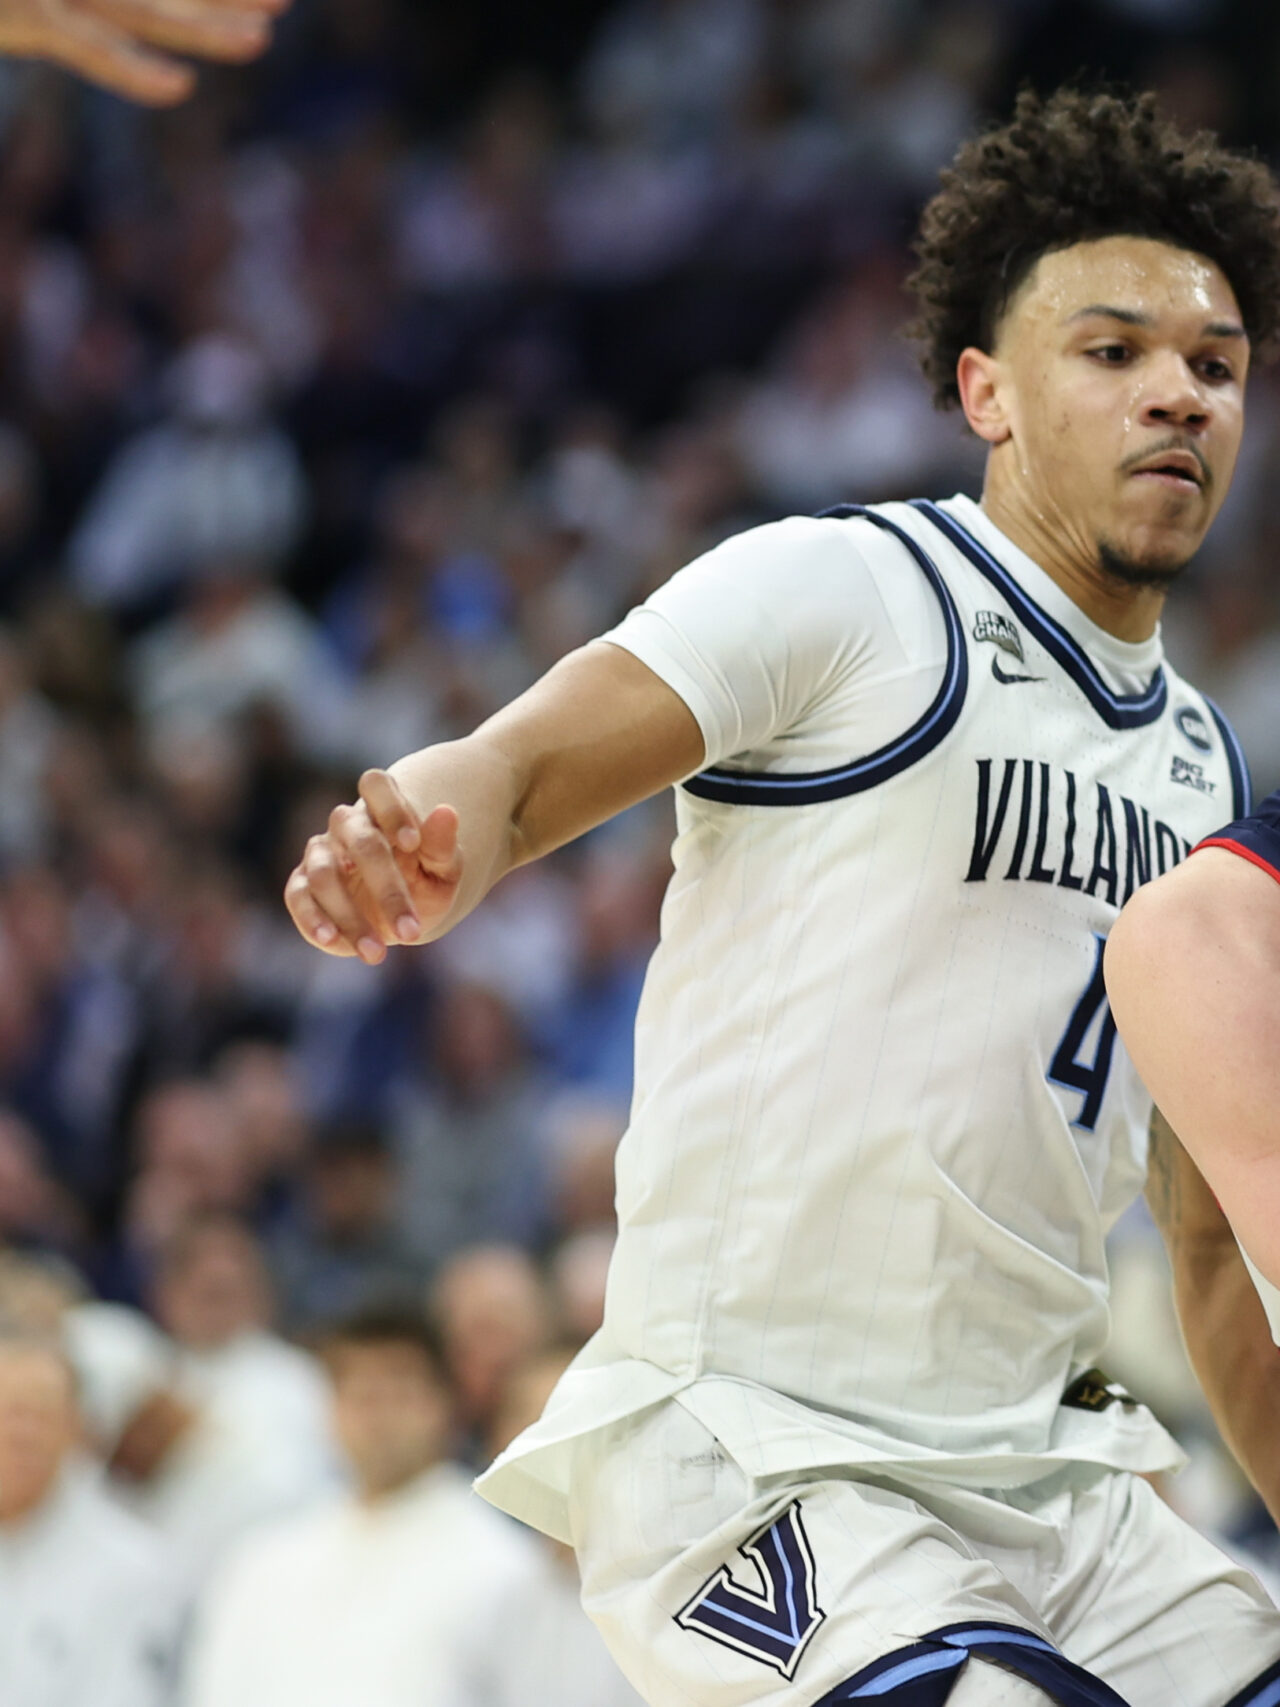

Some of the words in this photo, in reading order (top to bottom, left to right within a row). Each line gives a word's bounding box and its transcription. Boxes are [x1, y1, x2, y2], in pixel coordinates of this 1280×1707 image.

[964, 758, 1191, 909] VILLANO
[1171, 768, 1217, 794] EAST
[1173, 756, 1203, 777] BIG
[1046, 931, 1118, 1133] 4
[673, 1497, 828, 1683] V
